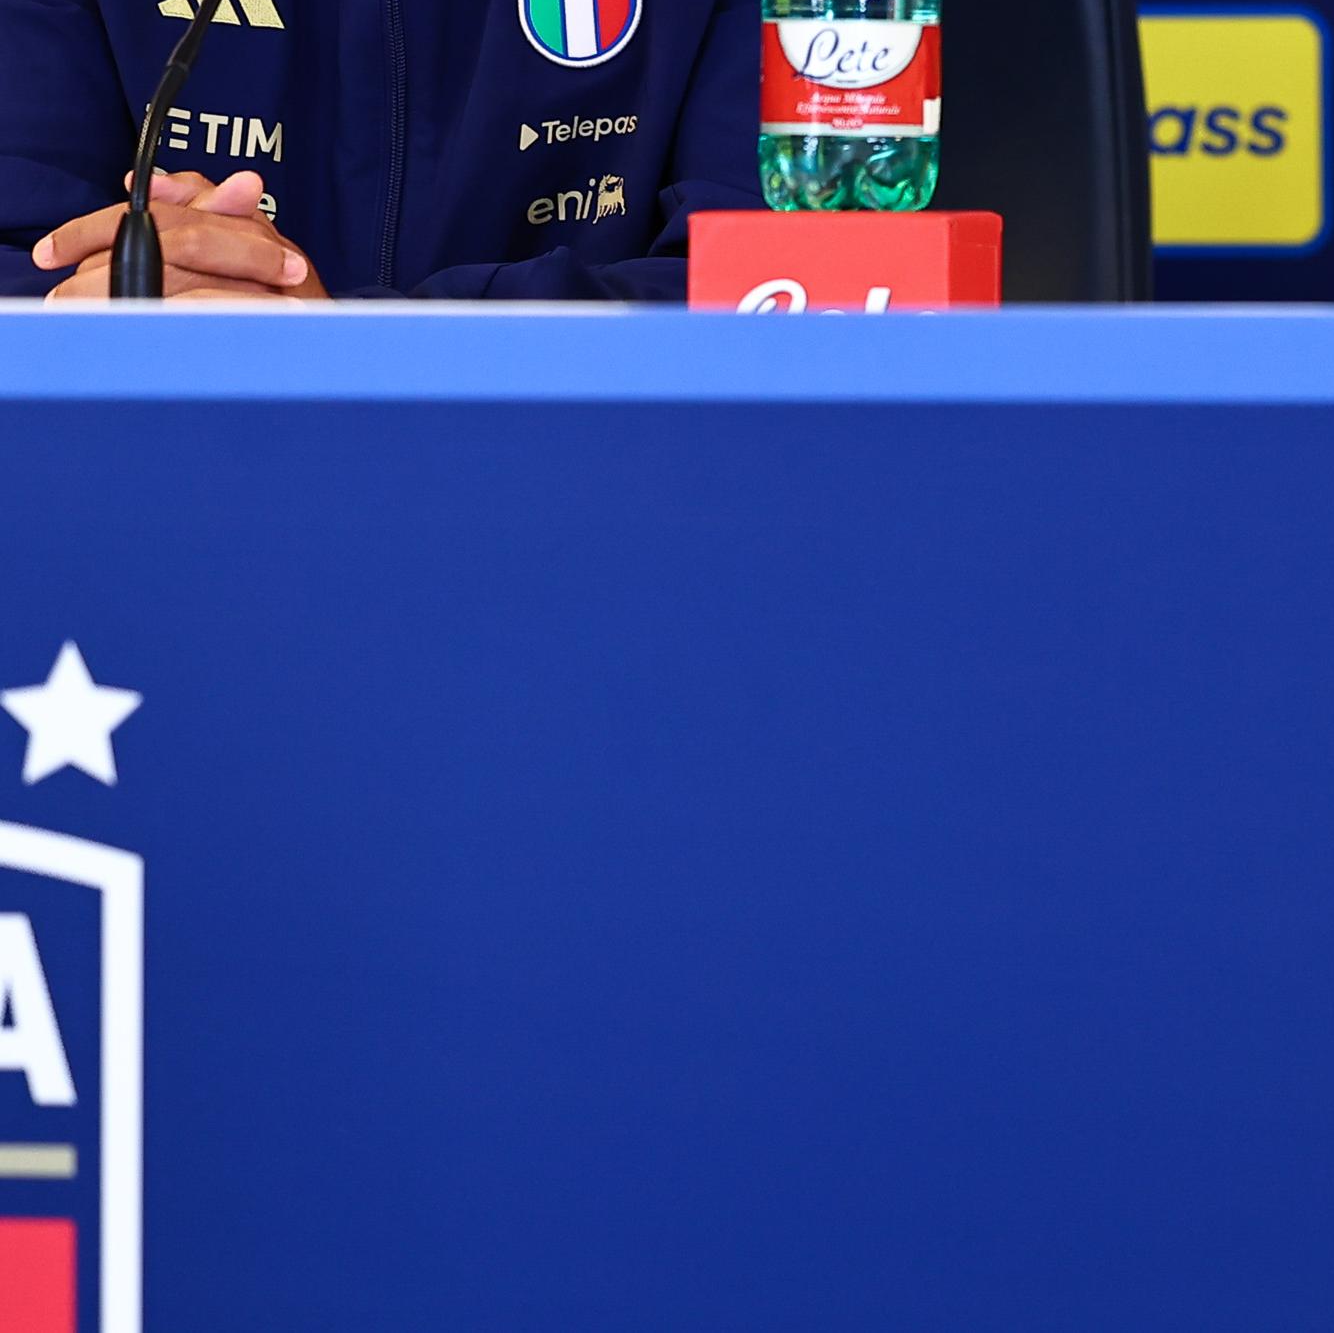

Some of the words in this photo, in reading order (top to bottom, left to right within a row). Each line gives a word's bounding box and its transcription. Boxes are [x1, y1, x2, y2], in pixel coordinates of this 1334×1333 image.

[793, 27, 889, 80] Lete
[199, 113, 283, 162] TIM
[527, 178, 597, 225] eni
